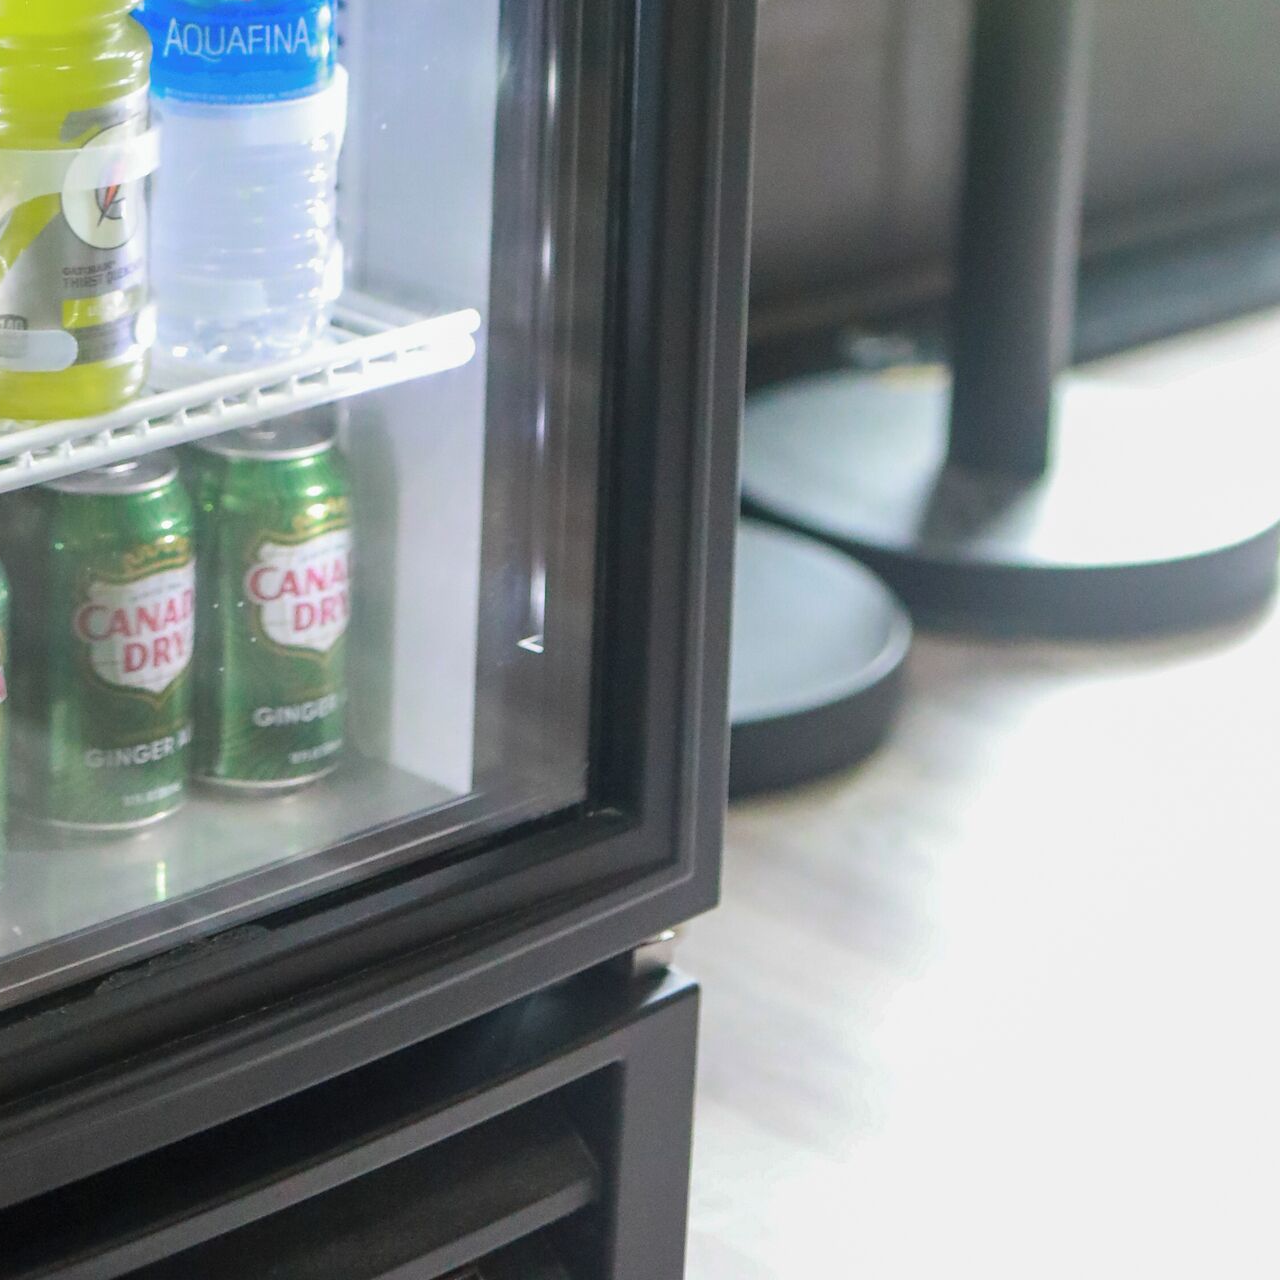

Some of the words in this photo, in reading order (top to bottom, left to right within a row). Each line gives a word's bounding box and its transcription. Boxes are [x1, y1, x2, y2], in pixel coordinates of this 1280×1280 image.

[162, 16, 315, 62] AQUAFINA
[250, 558, 348, 601] CANA
[77, 589, 193, 642] CANAD
[85, 736, 175, 768] GINGER
